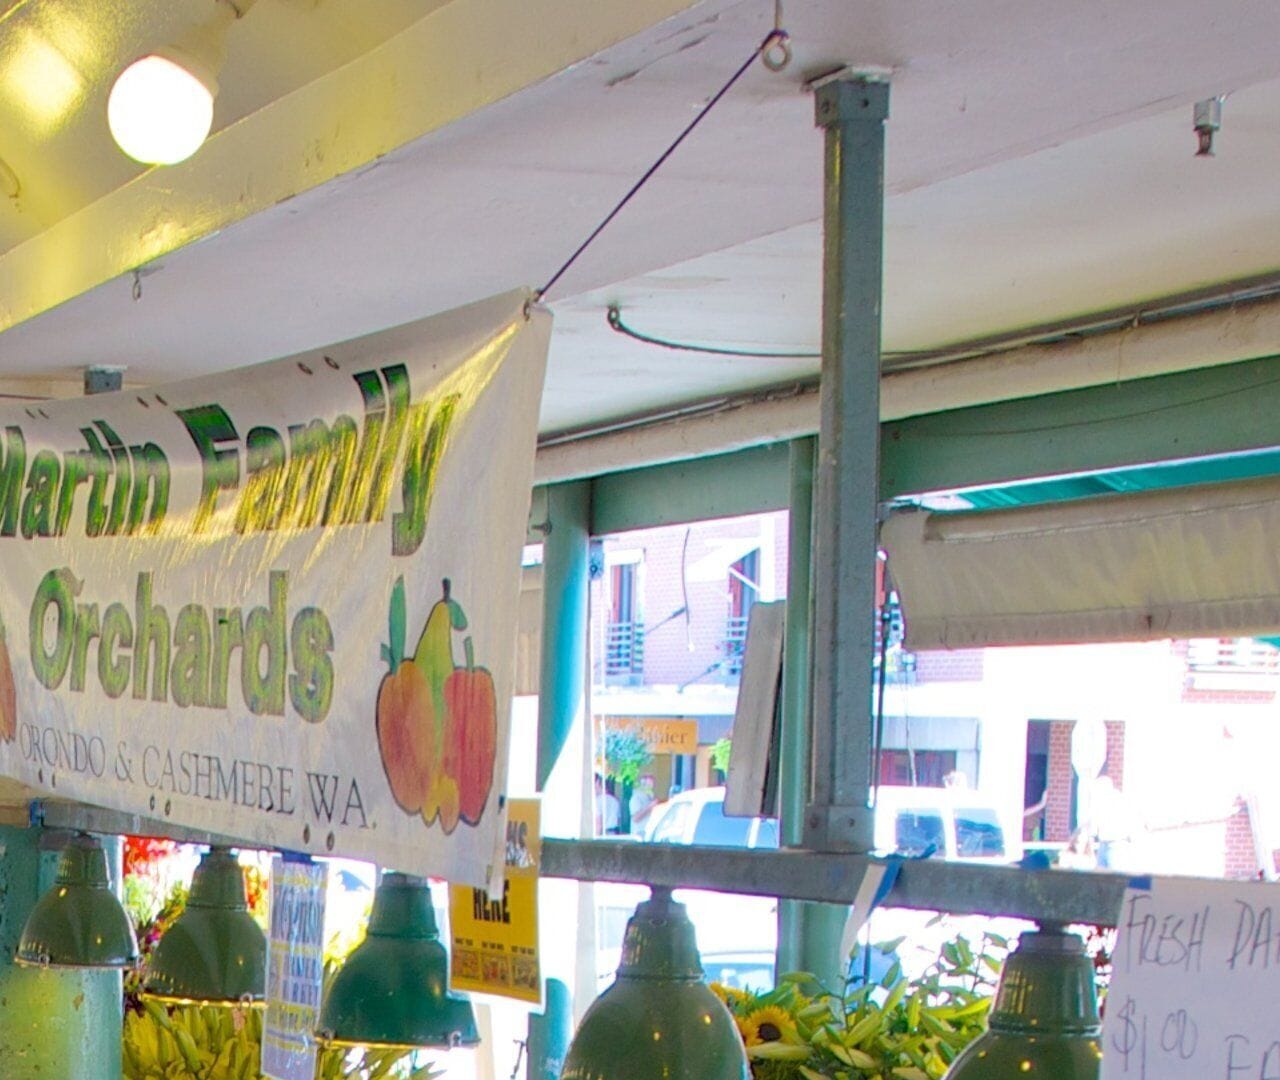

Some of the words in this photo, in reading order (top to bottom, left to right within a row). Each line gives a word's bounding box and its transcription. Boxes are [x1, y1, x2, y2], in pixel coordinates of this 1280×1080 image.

[177, 363, 461, 556] Family
[29, 566, 335, 724] Orchards
[19, 722, 106, 778] ORONDO
[114, 741, 135, 784] &
[1125, 893, 1209, 973] FRESH
[1226, 899, 1280, 970] DA
